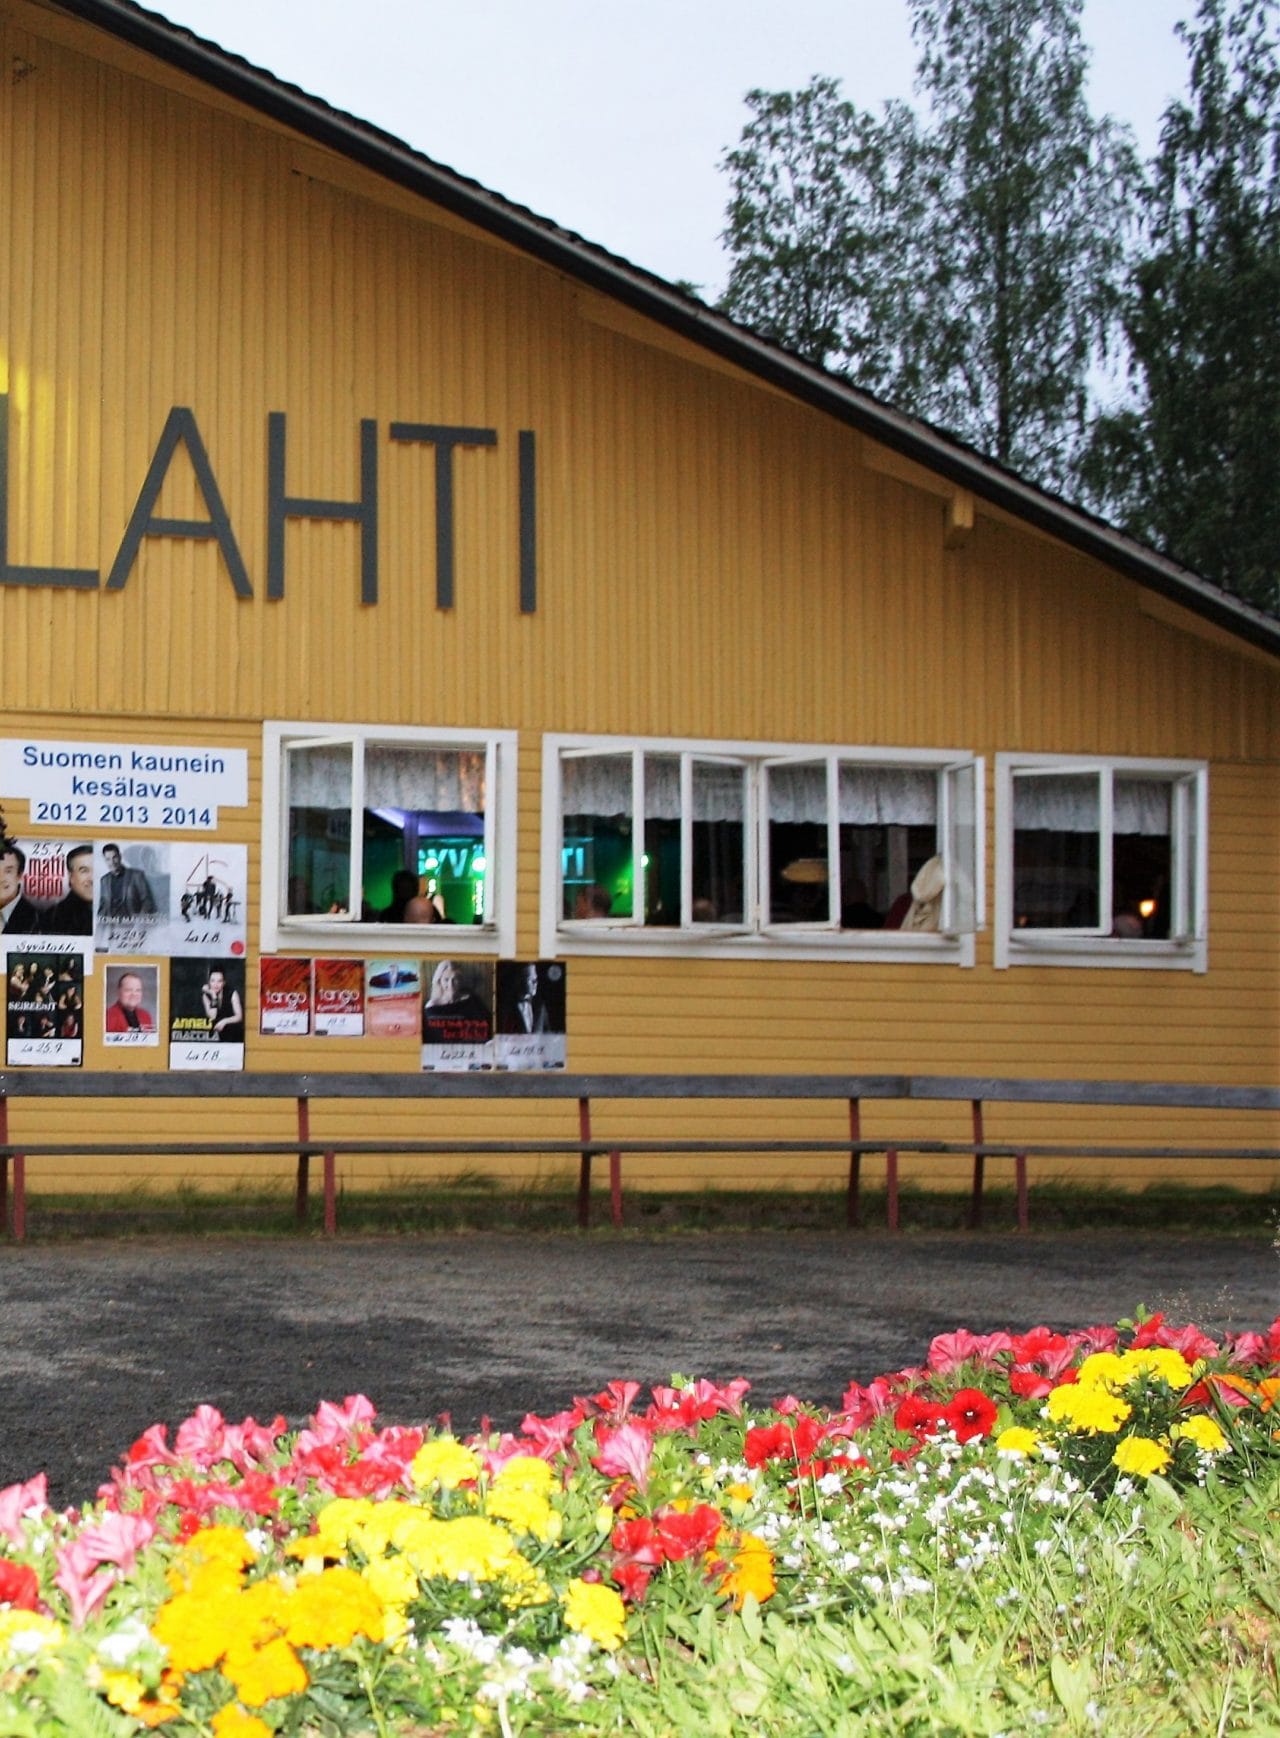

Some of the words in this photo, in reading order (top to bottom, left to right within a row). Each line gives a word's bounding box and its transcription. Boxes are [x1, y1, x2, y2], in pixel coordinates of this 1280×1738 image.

[23, 746, 122, 769] Suomen
[131, 752, 225, 773] kaunein
[73, 776, 177, 799] kesälava
[37, 803, 87, 822] 2012
[100, 805, 149, 824] 2013
[162, 807, 211, 826] 2014
[28, 855, 65, 878] matti
[24, 874, 64, 900] teppo
[265, 989, 307, 1010] tango
[319, 988, 360, 1006] tango
